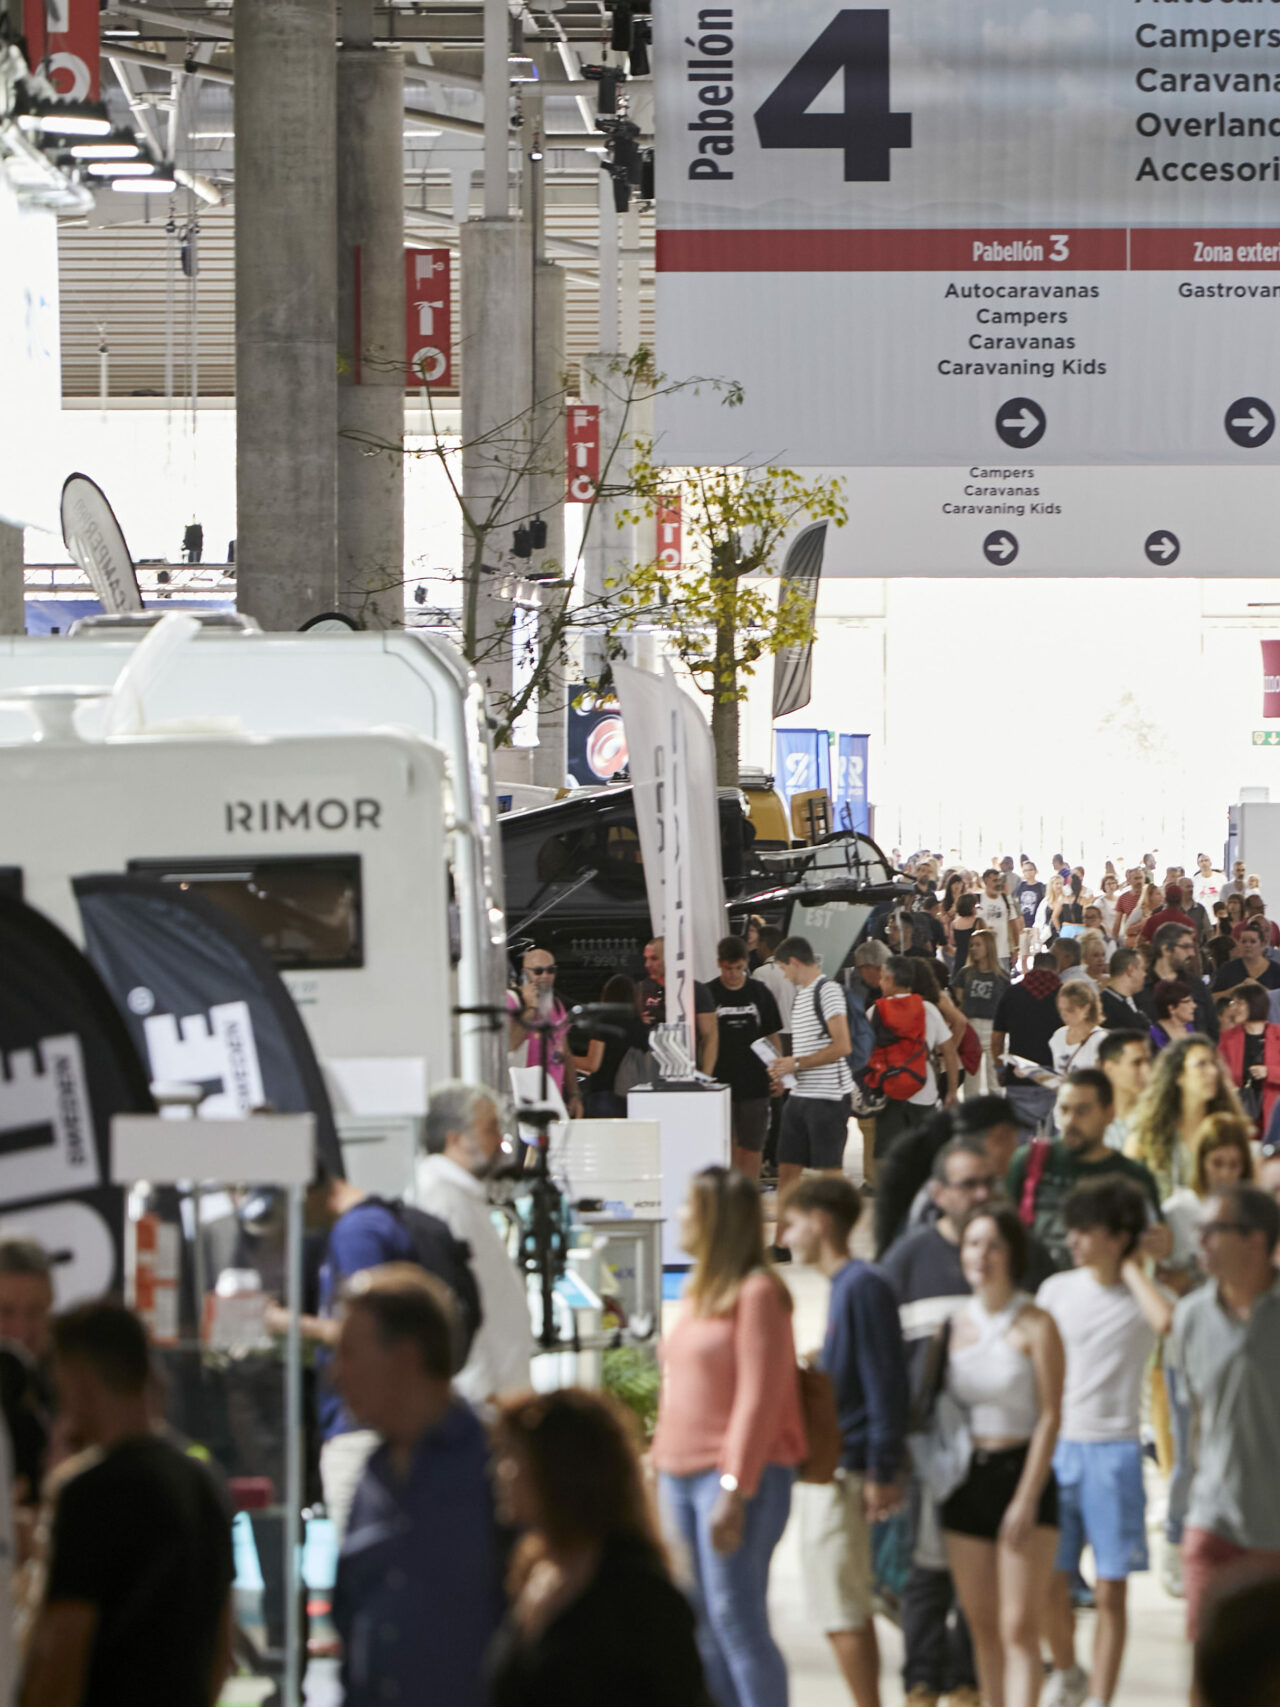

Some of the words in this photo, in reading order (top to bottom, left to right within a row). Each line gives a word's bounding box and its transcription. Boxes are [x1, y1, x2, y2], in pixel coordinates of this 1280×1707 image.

[687, 9, 734, 181] Pabellón
[753, 9, 912, 182] 4
[973, 241, 1044, 262] Pabellón
[1048, 234, 1070, 262] 3
[1193, 242, 1233, 263] Zona
[944, 283, 1100, 299] Autocaravanas
[976, 308, 1068, 326] Campers
[968, 334, 1076, 350] Caravanas
[937, 359, 1055, 378] Caravaning
[1062, 359, 1107, 376] Kids
[969, 467, 1035, 480] Campers
[964, 485, 1040, 496] Caravanas
[942, 503, 1025, 516] Caravaning
[1030, 503, 1062, 514] Kids
[225, 798, 381, 833] RIMOR
